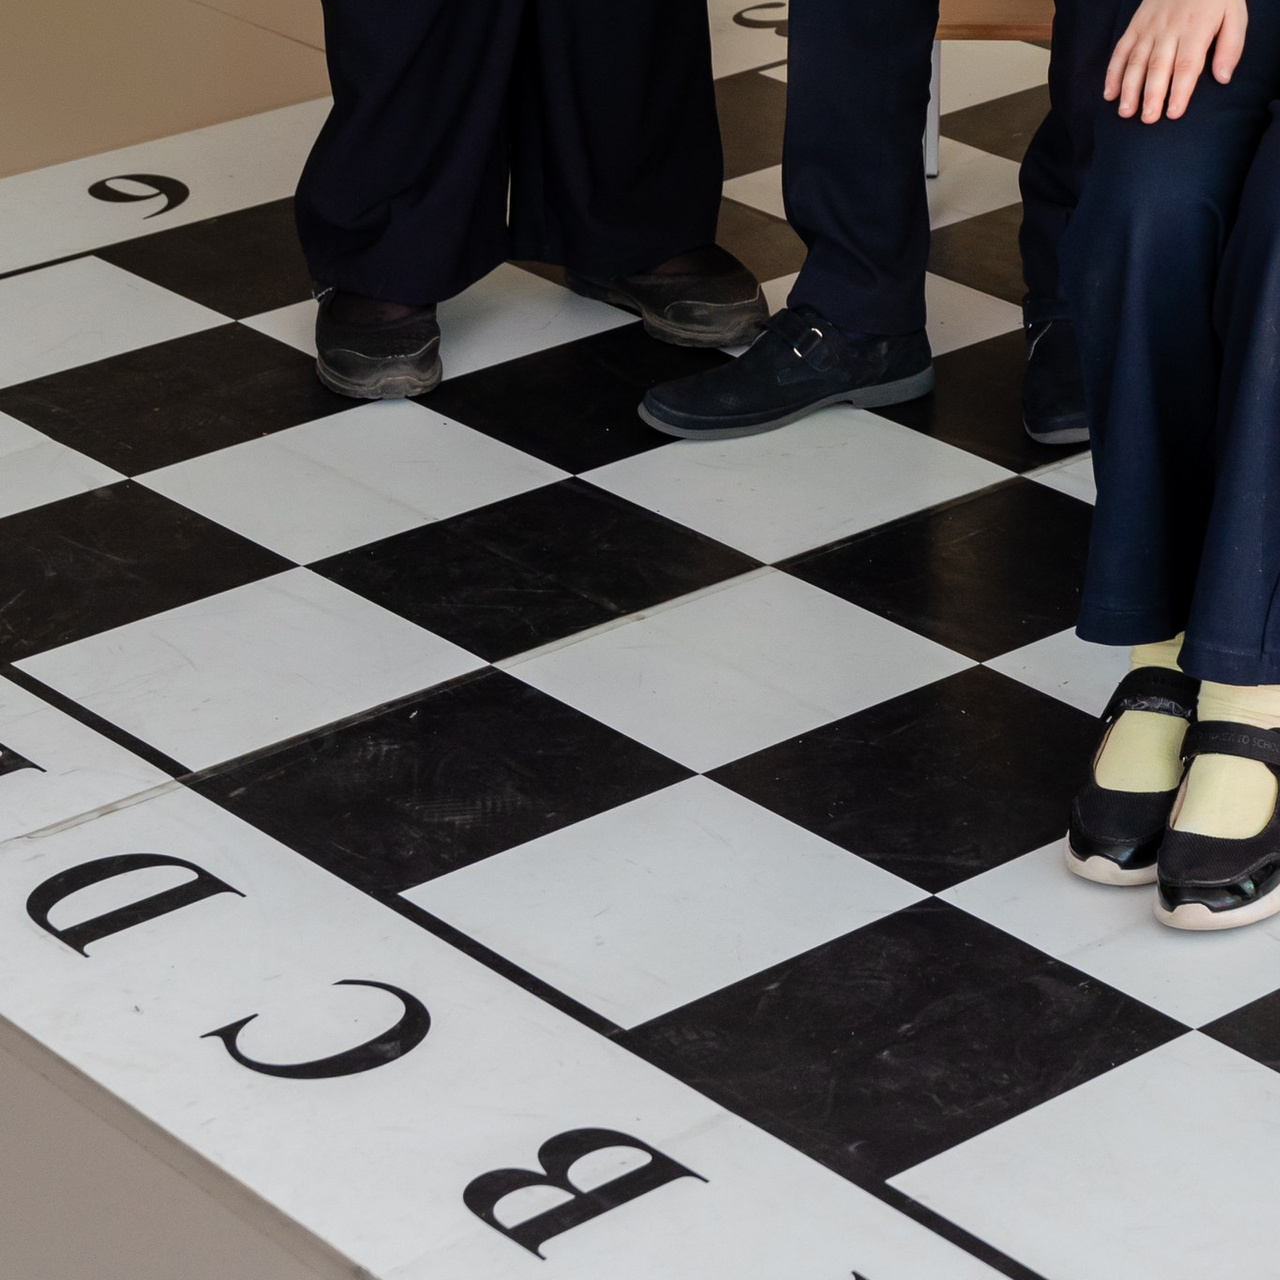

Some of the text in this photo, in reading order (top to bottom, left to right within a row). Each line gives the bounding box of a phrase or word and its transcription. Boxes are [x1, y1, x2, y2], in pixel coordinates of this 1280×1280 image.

[25, 852, 710, 1261] D C B
